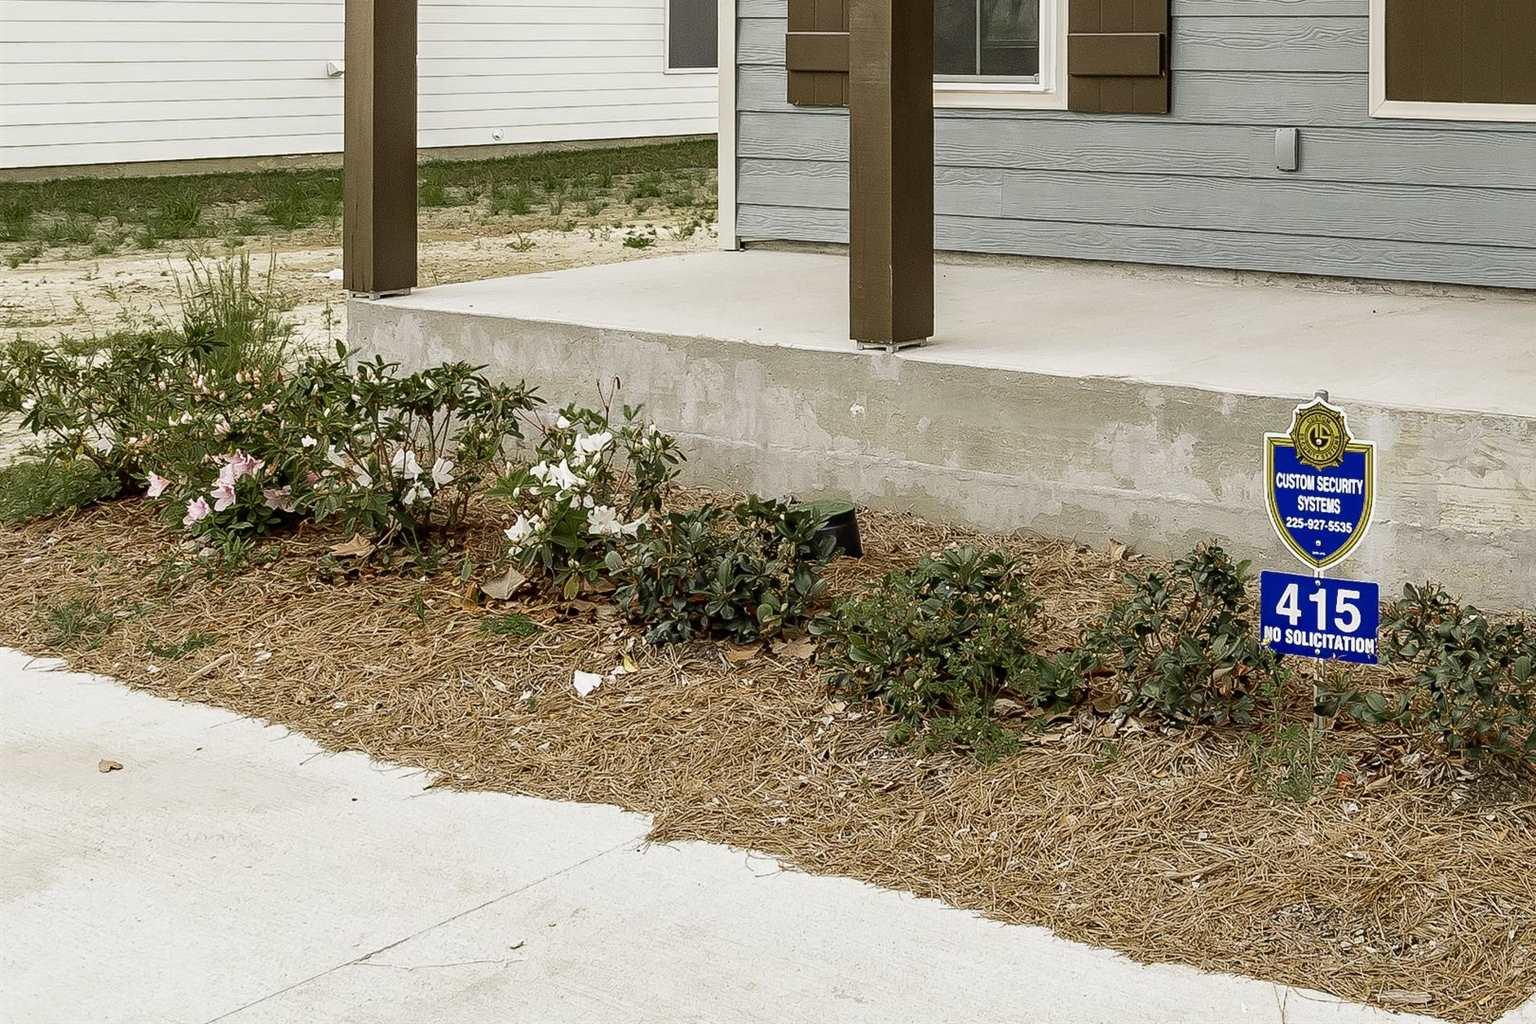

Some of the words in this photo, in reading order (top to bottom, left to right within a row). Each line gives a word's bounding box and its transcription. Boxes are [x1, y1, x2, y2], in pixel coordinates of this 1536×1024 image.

[1275, 472, 1315, 491] CUSTOM
[1316, 476, 1363, 495] SECURITY
[1297, 495, 1341, 514] SYSTEMS
[1286, 517, 1353, 534] 225-927-5535
[1275, 583, 1362, 633] 415
[1263, 625, 1282, 643] NO
[1285, 628, 1375, 655] SOLICITATION
